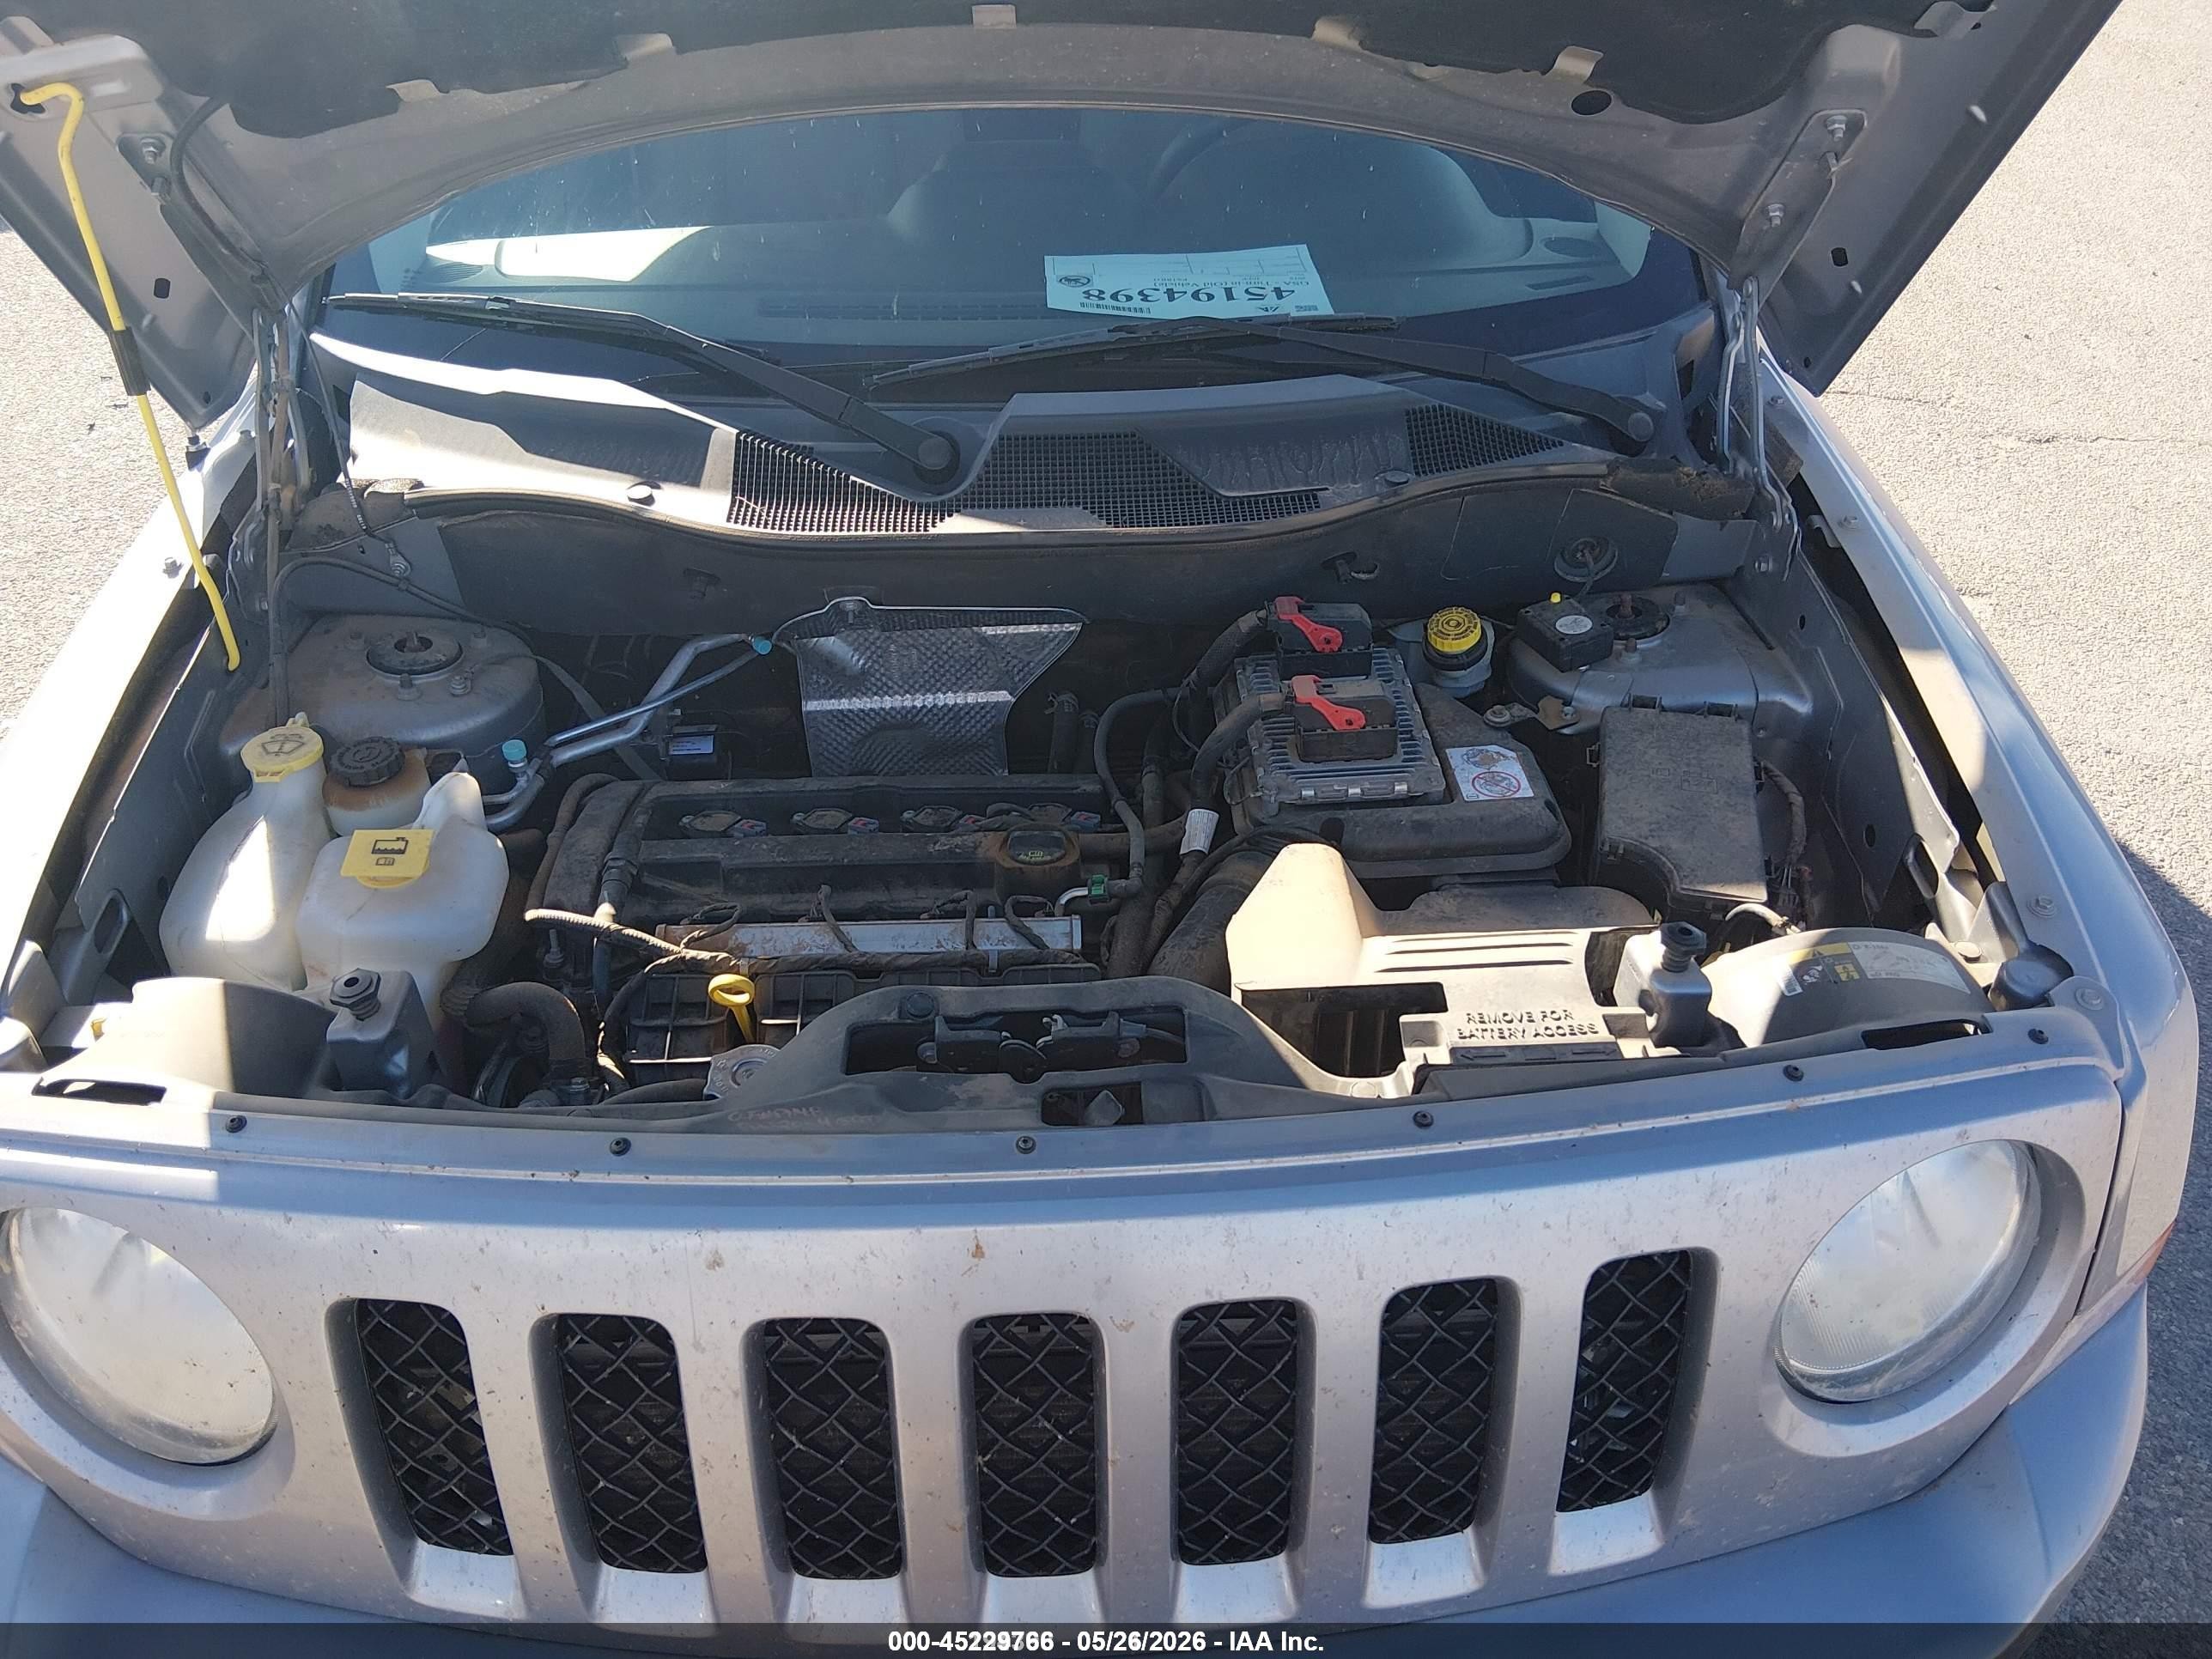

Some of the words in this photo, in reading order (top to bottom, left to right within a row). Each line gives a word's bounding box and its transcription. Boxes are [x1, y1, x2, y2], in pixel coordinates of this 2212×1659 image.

[1082, 286, 1296, 303] 45194398
[1466, 1012, 1536, 1024] REMOVE
[1540, 1009, 1575, 1022] FOR
[1457, 1026, 1527, 1040] BATTERY
[1533, 1023, 1600, 1038] ACCESS
